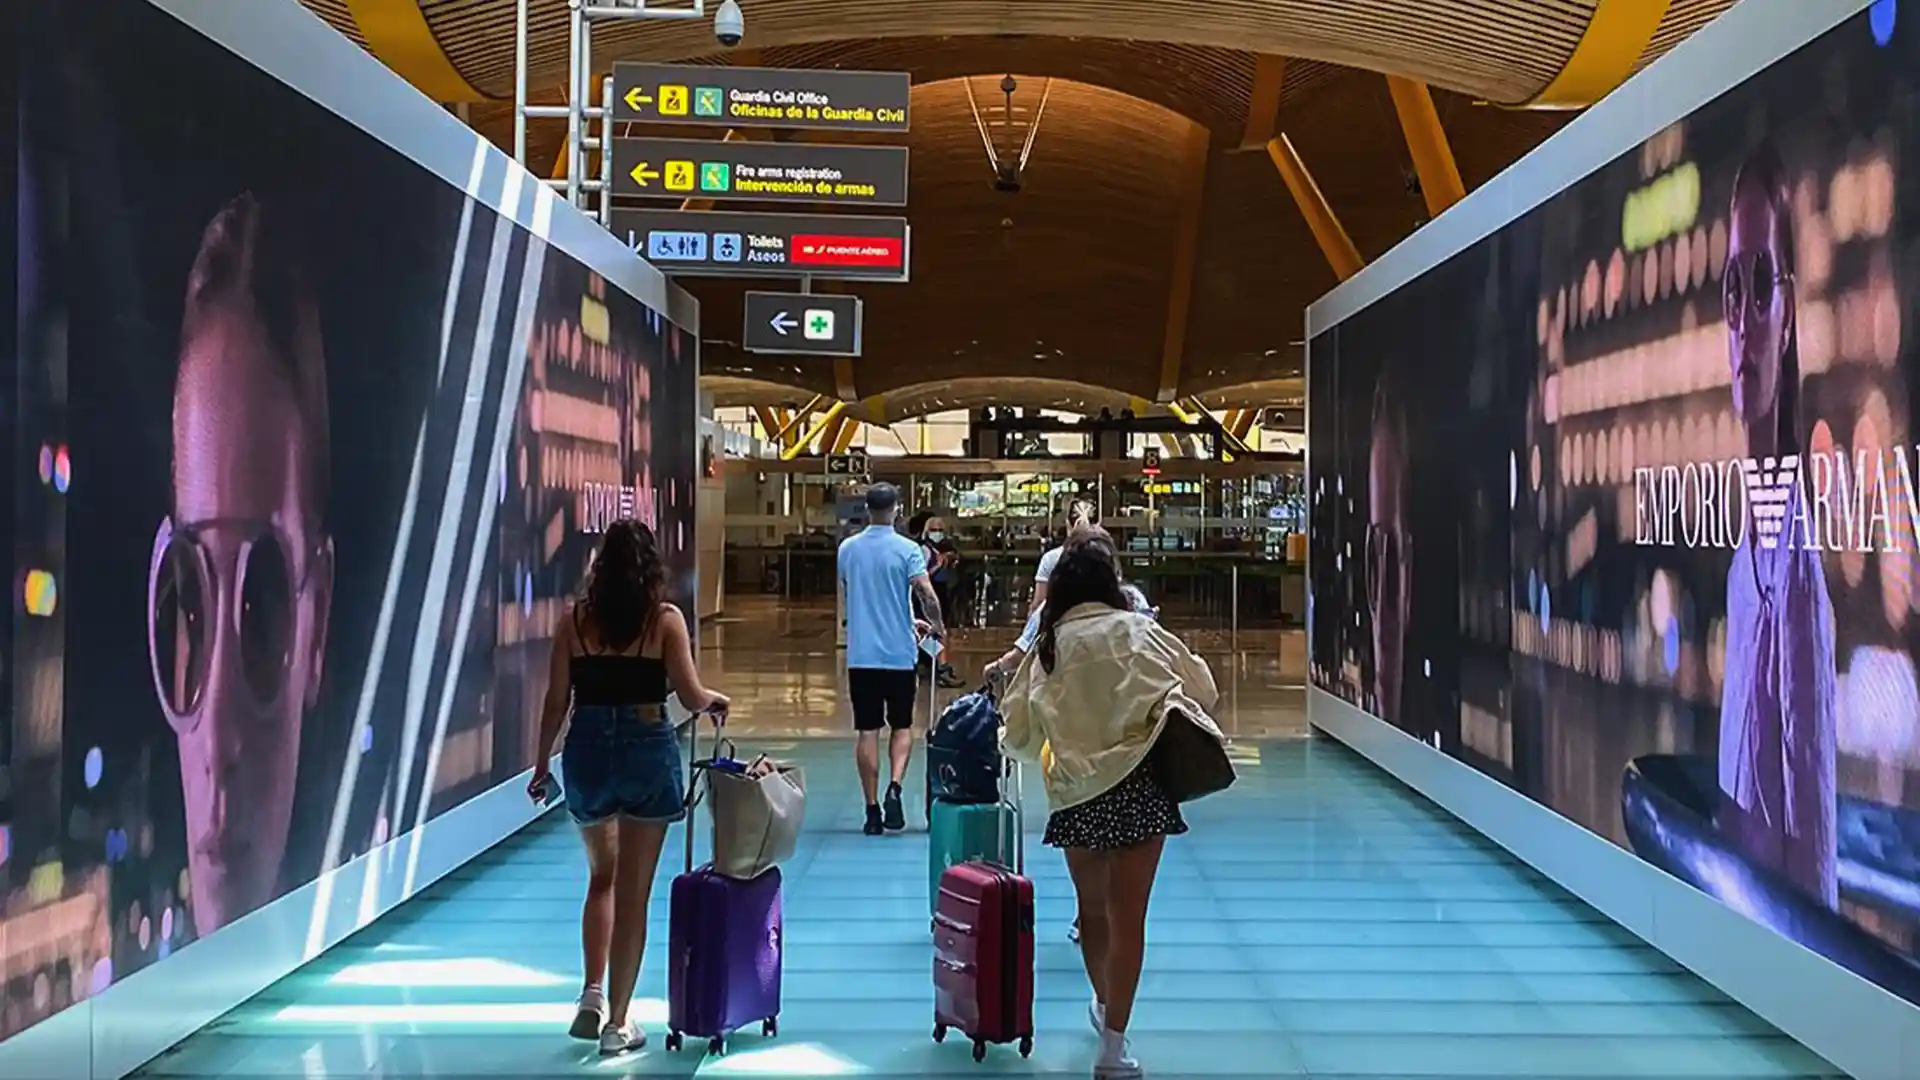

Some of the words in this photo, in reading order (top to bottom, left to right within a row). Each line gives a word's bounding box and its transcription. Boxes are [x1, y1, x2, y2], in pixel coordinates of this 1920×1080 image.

[730, 89, 771, 103] Guardia
[773, 91, 795, 103] Civil
[797, 92, 829, 105] Office
[730, 103, 783, 118] Oficinas
[787, 106, 803, 118] de
[807, 106, 819, 119] la
[823, 107, 873, 121] Guardia
[876, 108, 904, 122] Civil
[736, 164, 755, 177] Fire
[758, 167, 783, 178] arms
[786, 167, 842, 180] registration
[736, 178, 813, 193] Intervención
[816, 181, 832, 194] de
[835, 184, 875, 196] armas
[747, 234, 784, 248] Toilets
[747, 250, 785, 262] Aseos
[1634, 458, 1746, 549] EMPORIO
